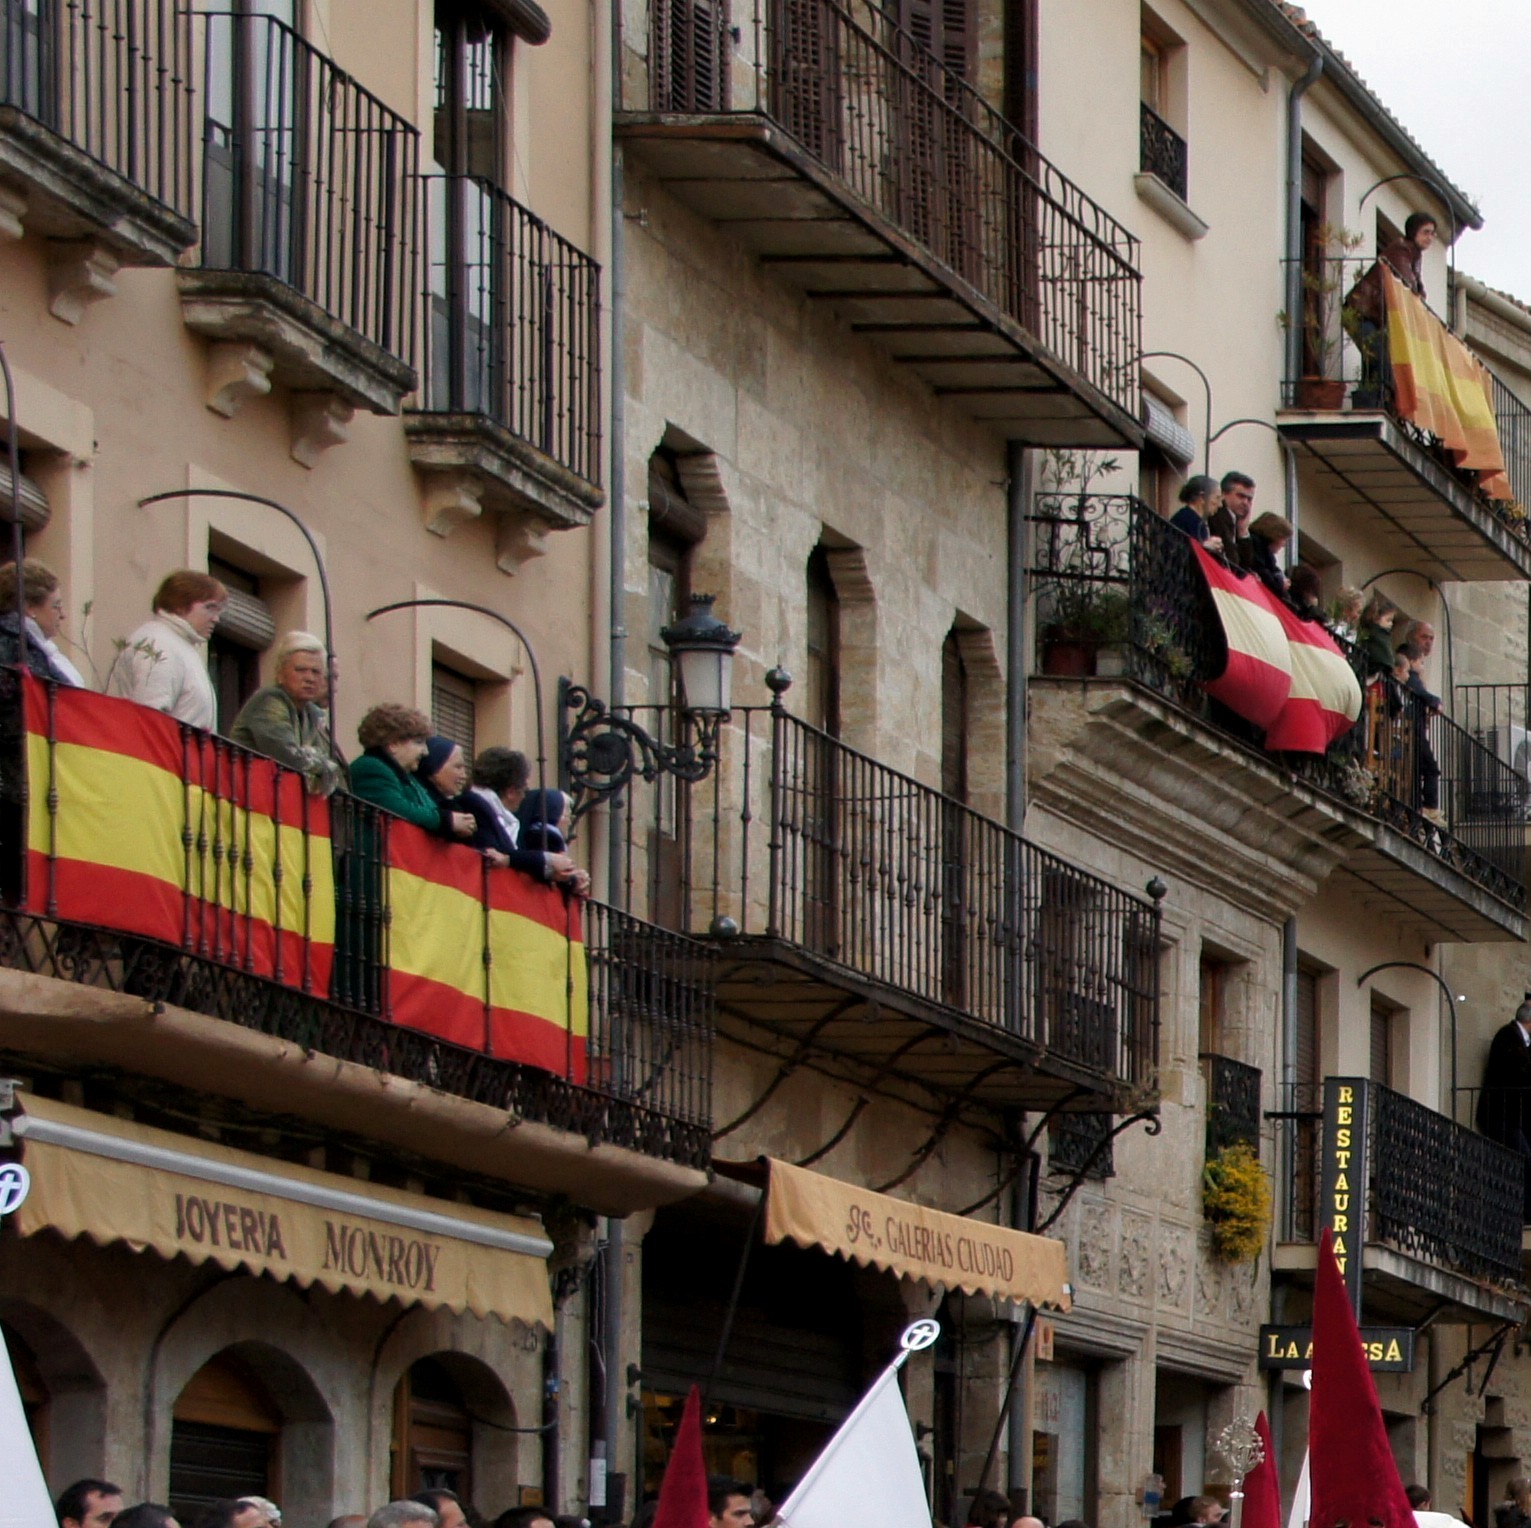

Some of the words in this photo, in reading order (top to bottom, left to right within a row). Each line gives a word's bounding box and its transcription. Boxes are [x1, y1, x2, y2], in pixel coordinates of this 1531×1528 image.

[1332, 1086, 1354, 1286] RESTAURAN
[322, 1220, 441, 1292] MONROY
[886, 1216, 955, 1269] GALERIAS
[957, 1236, 1014, 1282] CIUDAD
